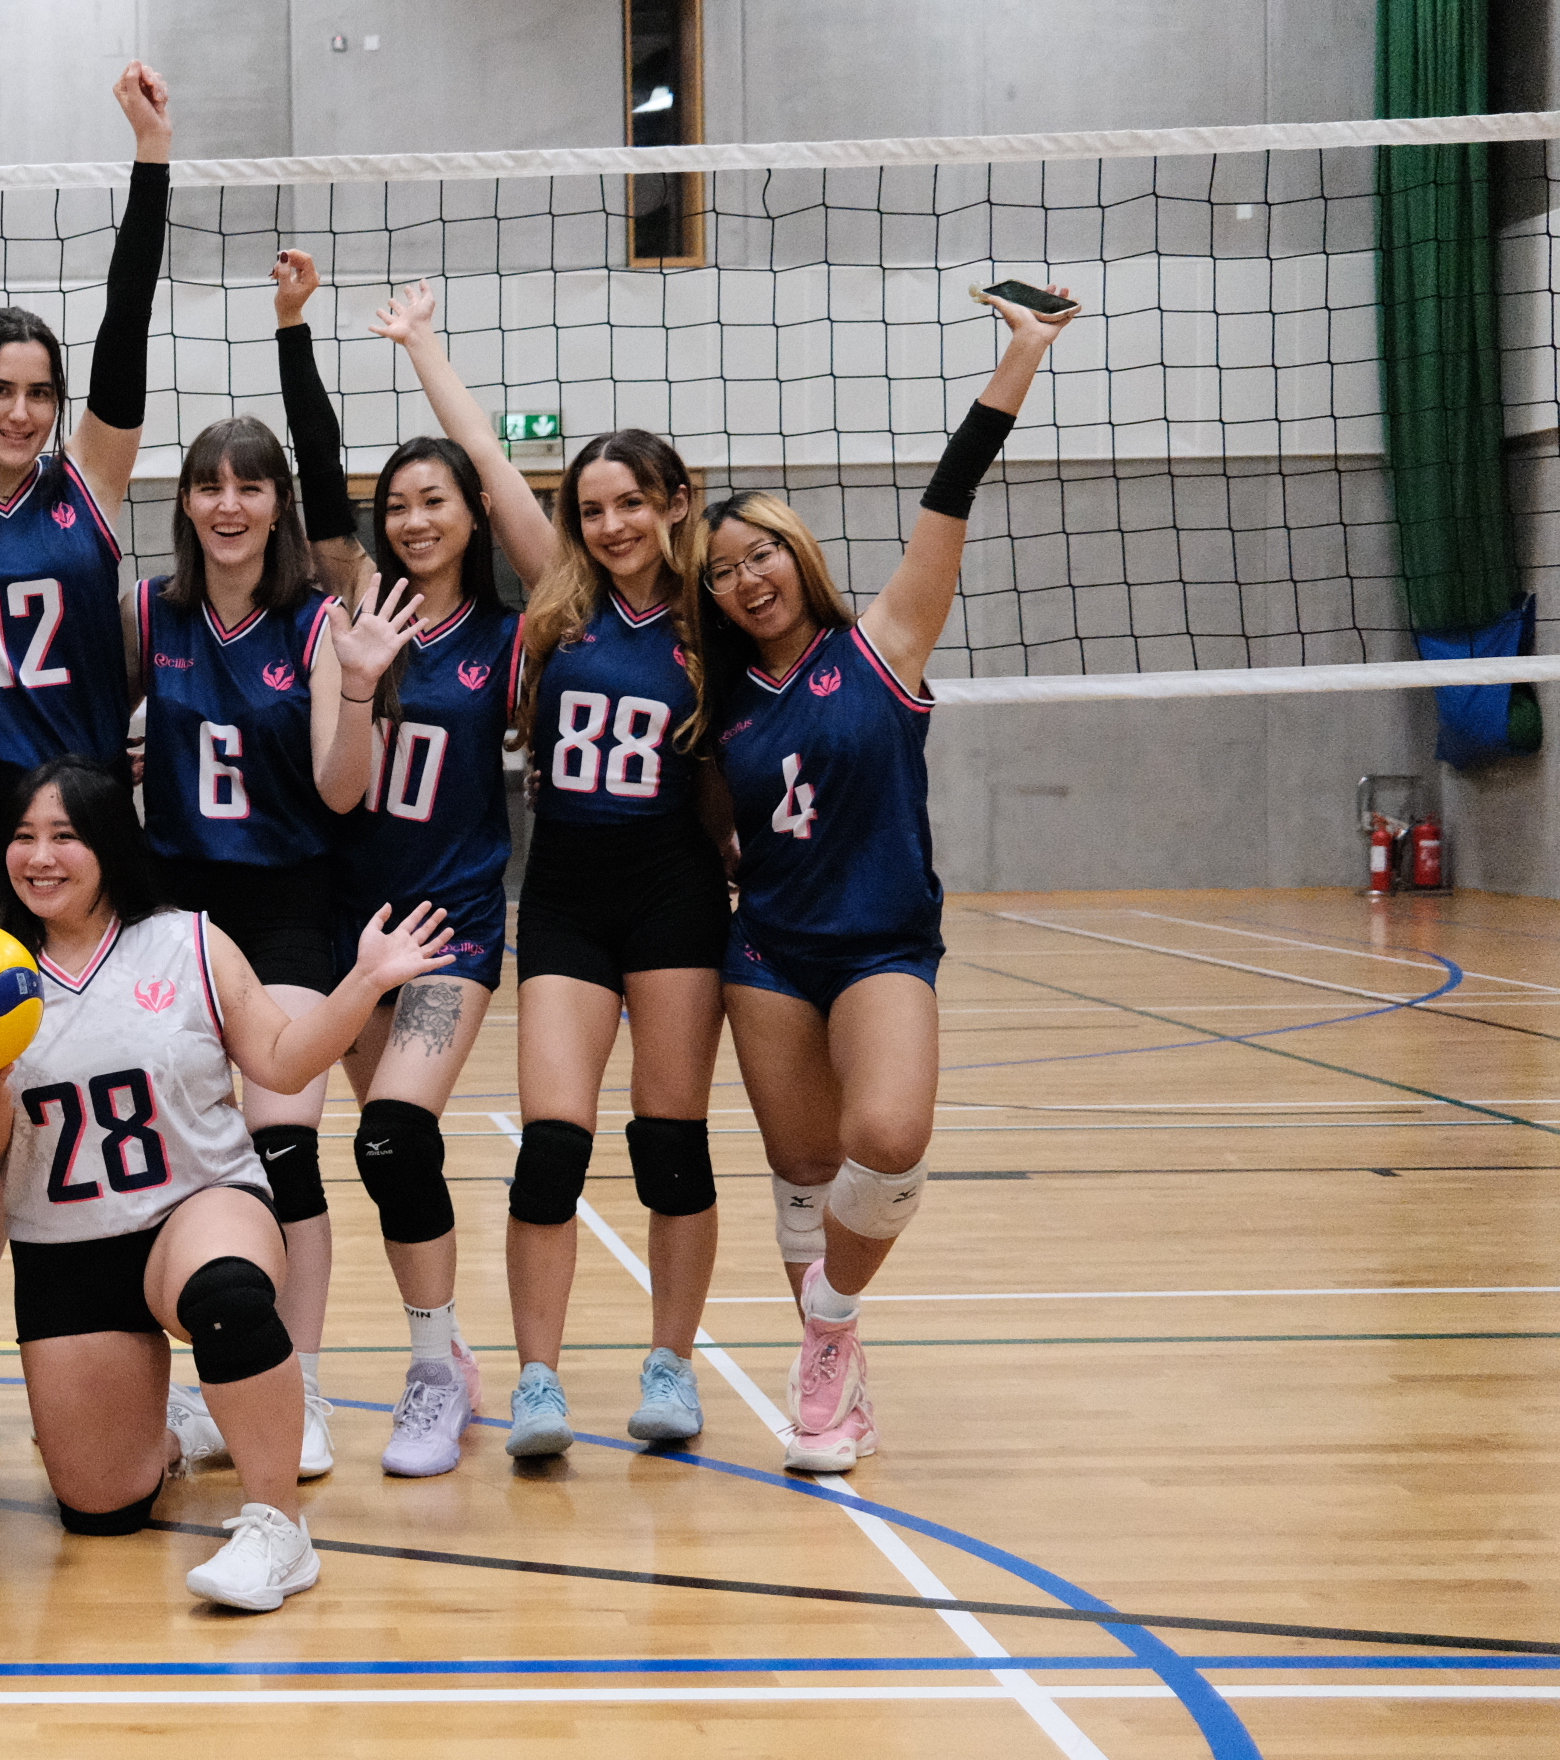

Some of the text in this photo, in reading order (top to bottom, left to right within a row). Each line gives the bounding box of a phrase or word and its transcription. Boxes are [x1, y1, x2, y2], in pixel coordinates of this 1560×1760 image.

[199, 721, 250, 819] 6
[552, 690, 671, 797] 88
[772, 753, 817, 839] 4
[21, 1068, 172, 1204] 28
